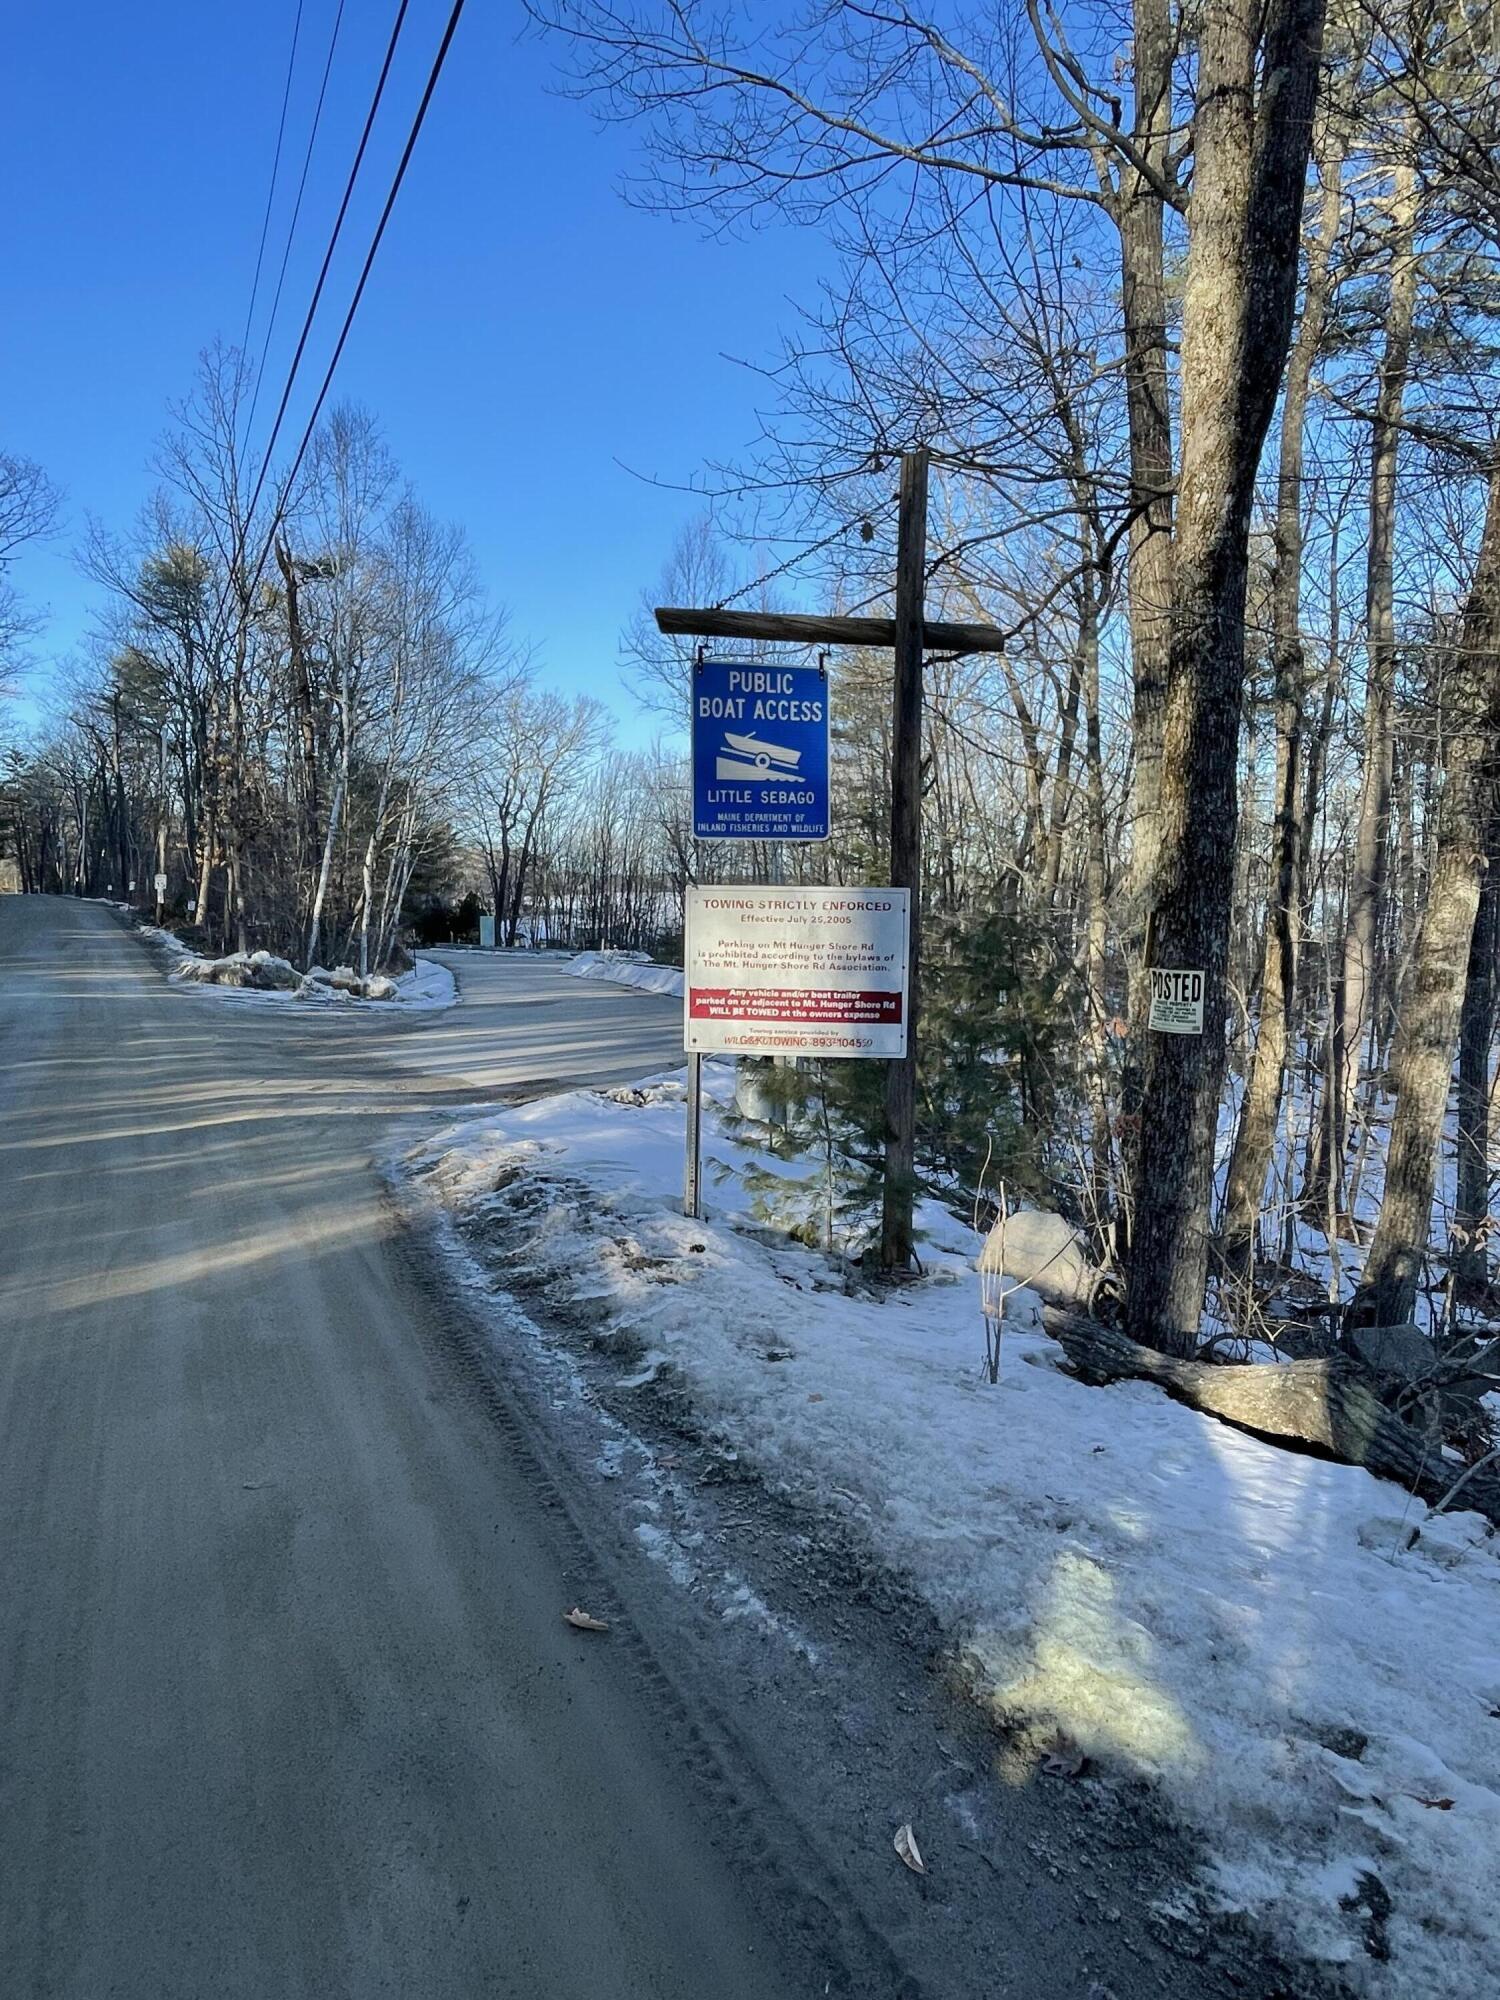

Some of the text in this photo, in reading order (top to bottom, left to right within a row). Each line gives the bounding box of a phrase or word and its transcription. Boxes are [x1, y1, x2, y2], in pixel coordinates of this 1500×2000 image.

[729, 671, 793, 694] PUBLIC
[700, 697, 822, 722] BOAT ACCESS
[707, 790, 815, 805] LITTLE SEBAGO
[717, 813, 806, 823] MAINE DEPARTMENT OF
[697, 823, 825, 833] INLAND FISHERIES AND WILDLIFE
[703, 899, 892, 911] TOWING STRICTLY ENFORCED
[740, 914, 785, 923] Effective
[787, 915, 808, 925] July
[718, 940, 755, 950] Parking
[773, 941, 787, 949] Mt
[789, 942, 825, 951] Hunger
[828, 942, 858, 951] Shore
[861, 943, 874, 951] Rd
[698, 949, 706, 957] is
[708, 951, 758, 959] prohibited
[761, 952, 810, 961] according
[827, 953, 843, 961] the
[846, 953, 880, 962] bylaws
[884, 953, 895, 961] of
[703, 959, 720, 968] The
[742, 960, 777, 970] Hunger
[780, 961, 809, 970] Shore
[813, 962, 826, 970] Rd
[829, 962, 890, 972] Association.
[1152, 970, 1202, 1002] POSTED
[729, 989, 861, 999] Any vehicle and/or boat trailer
[695, 997, 726, 1006] parked
[752, 998, 788, 1007] adjacent
[791, 999, 801, 1007] to
[820, 1000, 853, 1009] Hunger
[854, 1001, 881, 1009] Shore
[883, 1001, 896, 1009] Rd
[709, 1006, 881, 1019] WILL BE TOWED at the owners expense
